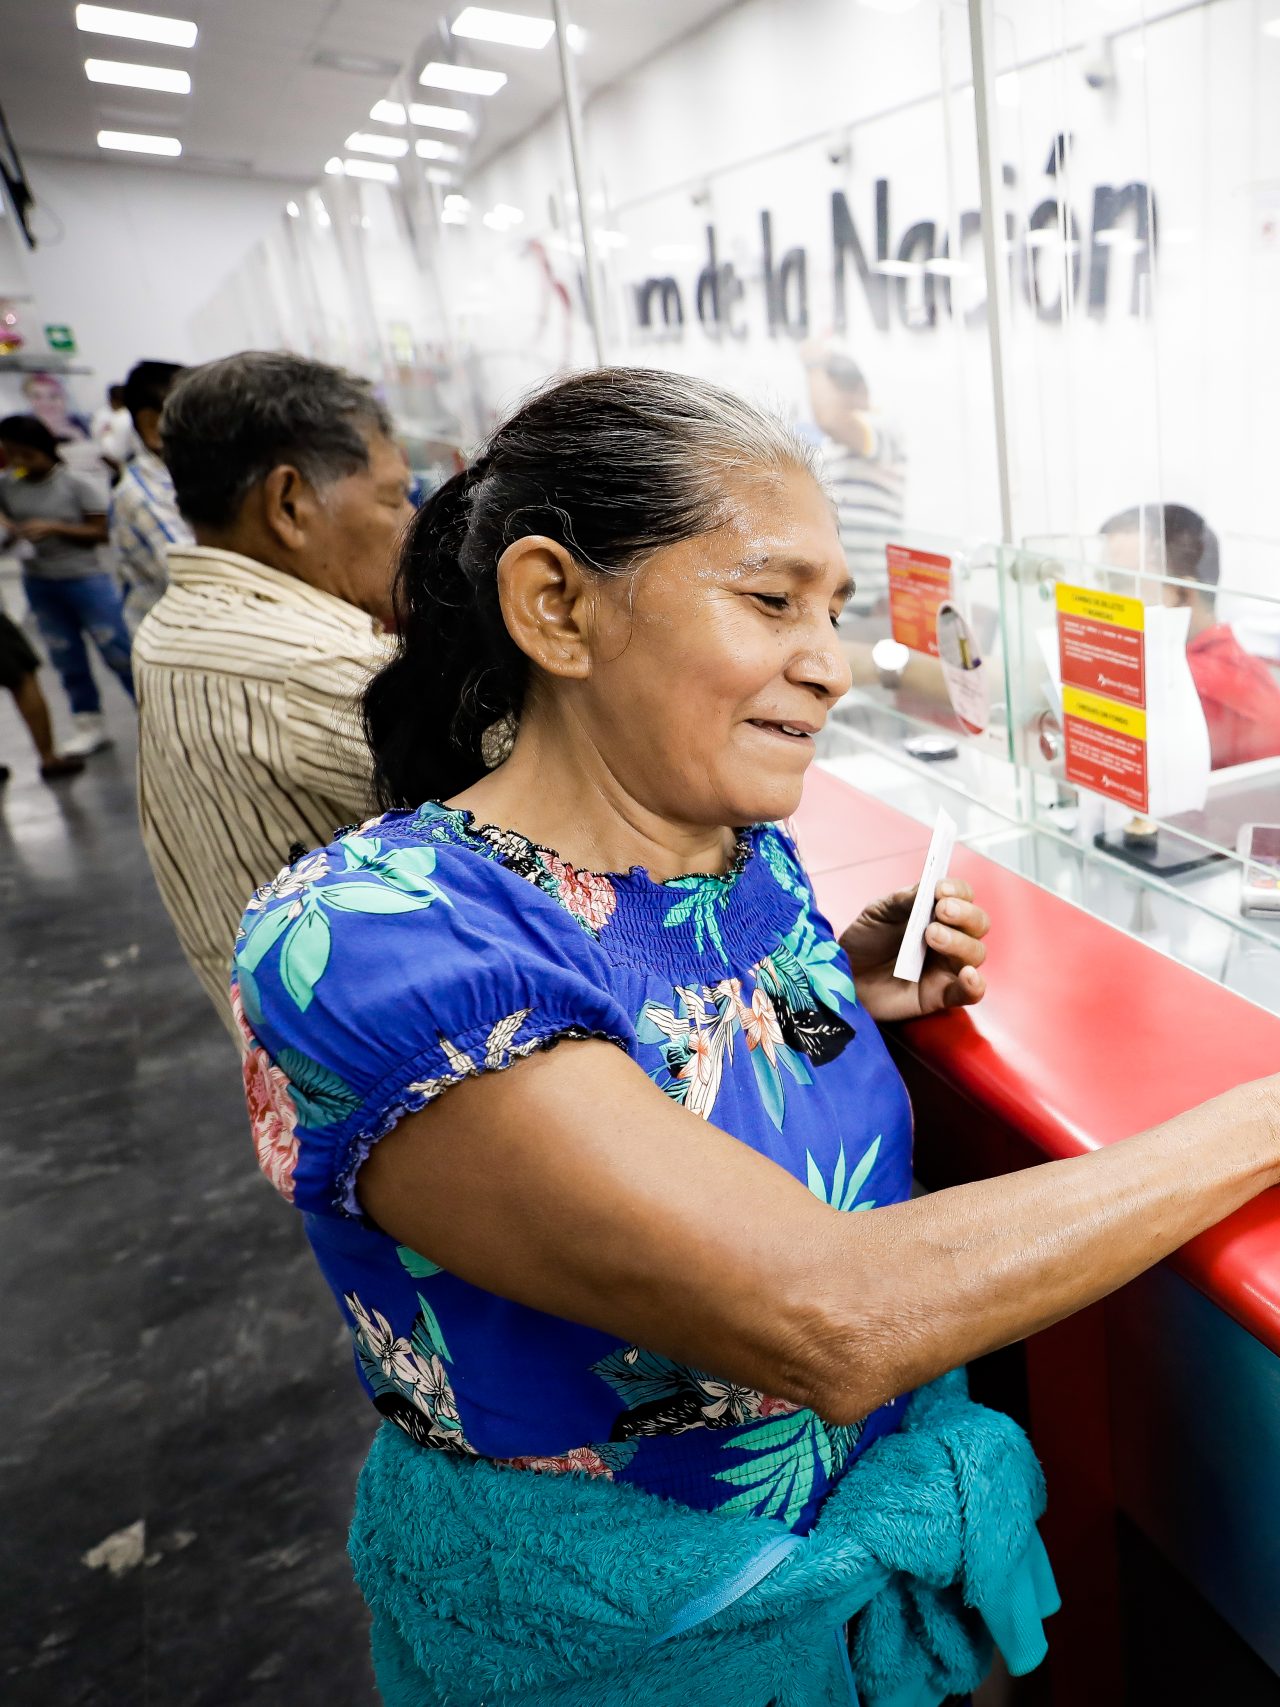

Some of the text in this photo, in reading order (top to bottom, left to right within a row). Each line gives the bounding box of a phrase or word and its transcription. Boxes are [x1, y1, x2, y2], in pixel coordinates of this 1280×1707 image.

[697, 224, 747, 339] de
[761, 209, 809, 339] la
[831, 132, 1158, 333] Nación
